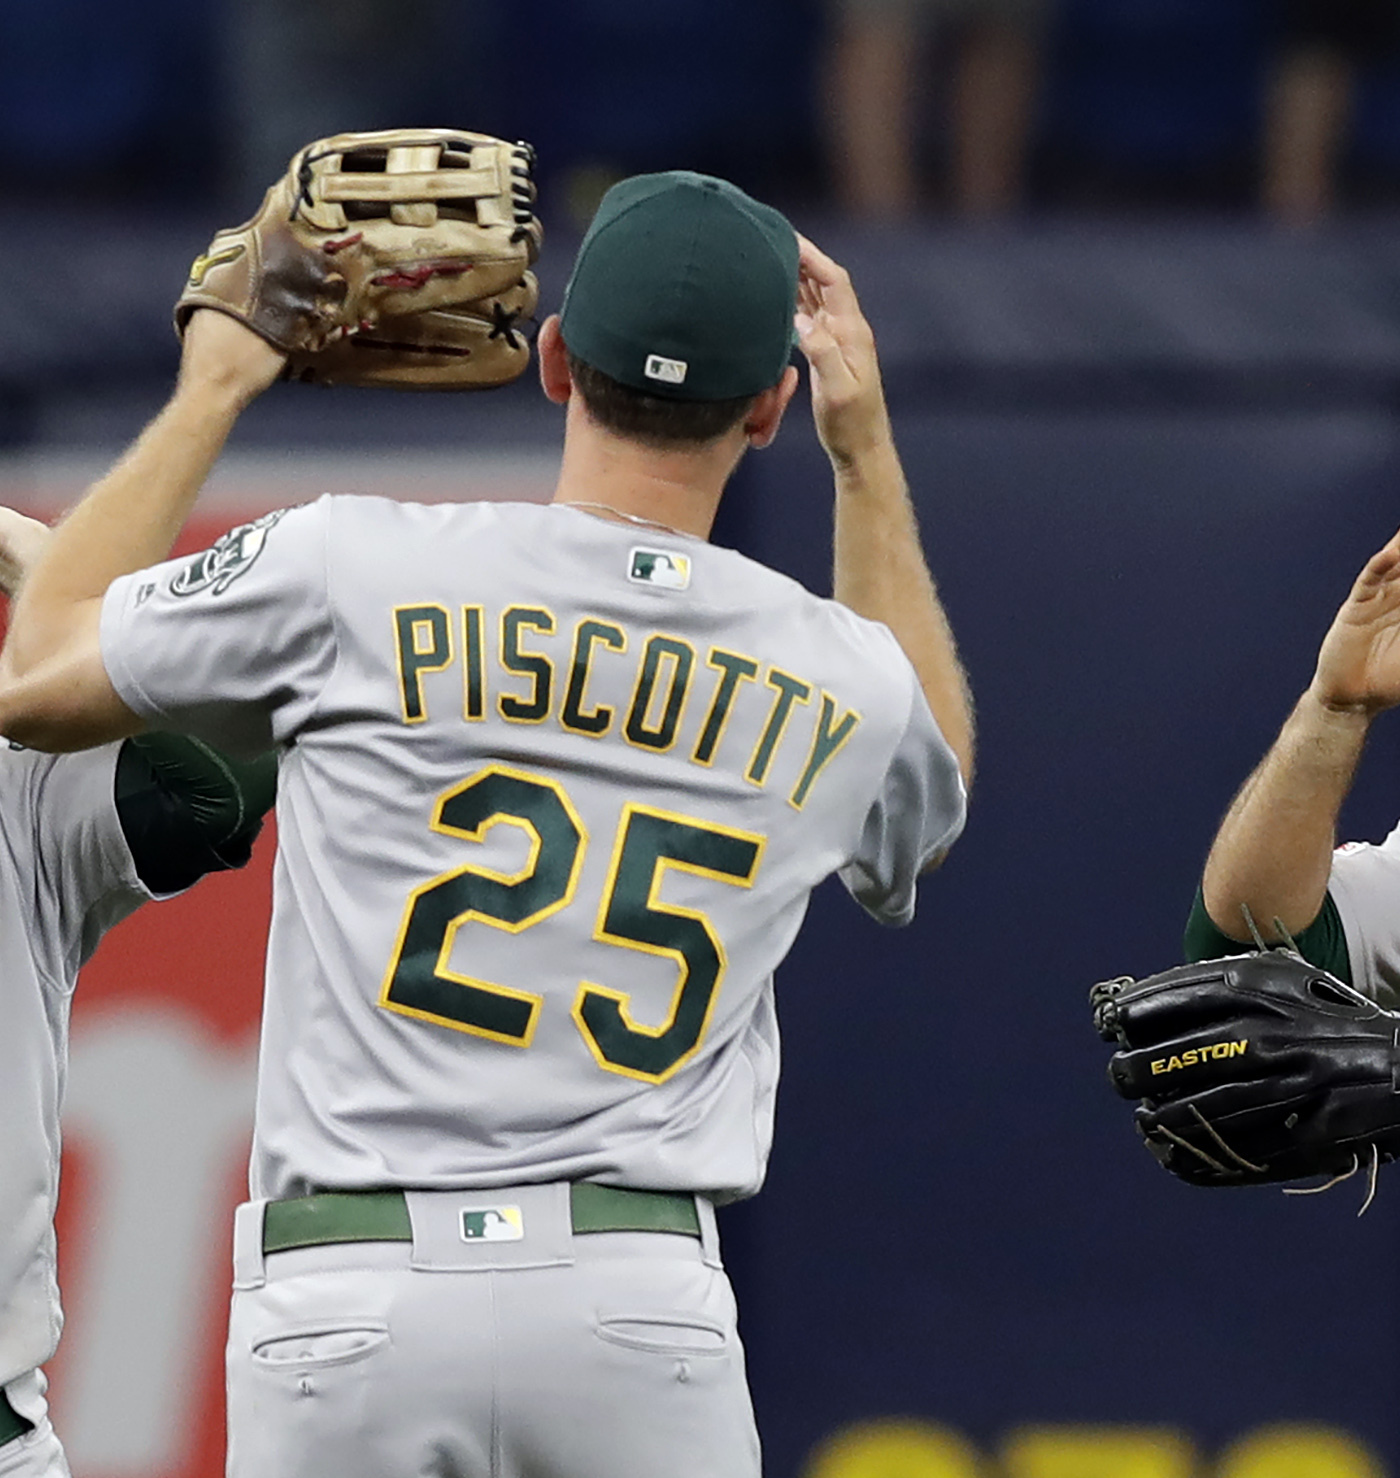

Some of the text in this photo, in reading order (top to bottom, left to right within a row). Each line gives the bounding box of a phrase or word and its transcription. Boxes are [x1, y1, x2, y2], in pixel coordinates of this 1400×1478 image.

[392, 603, 862, 811] PISCOTTY
[377, 763, 768, 1086] 25
[1150, 1038, 1249, 1076] EASTON
